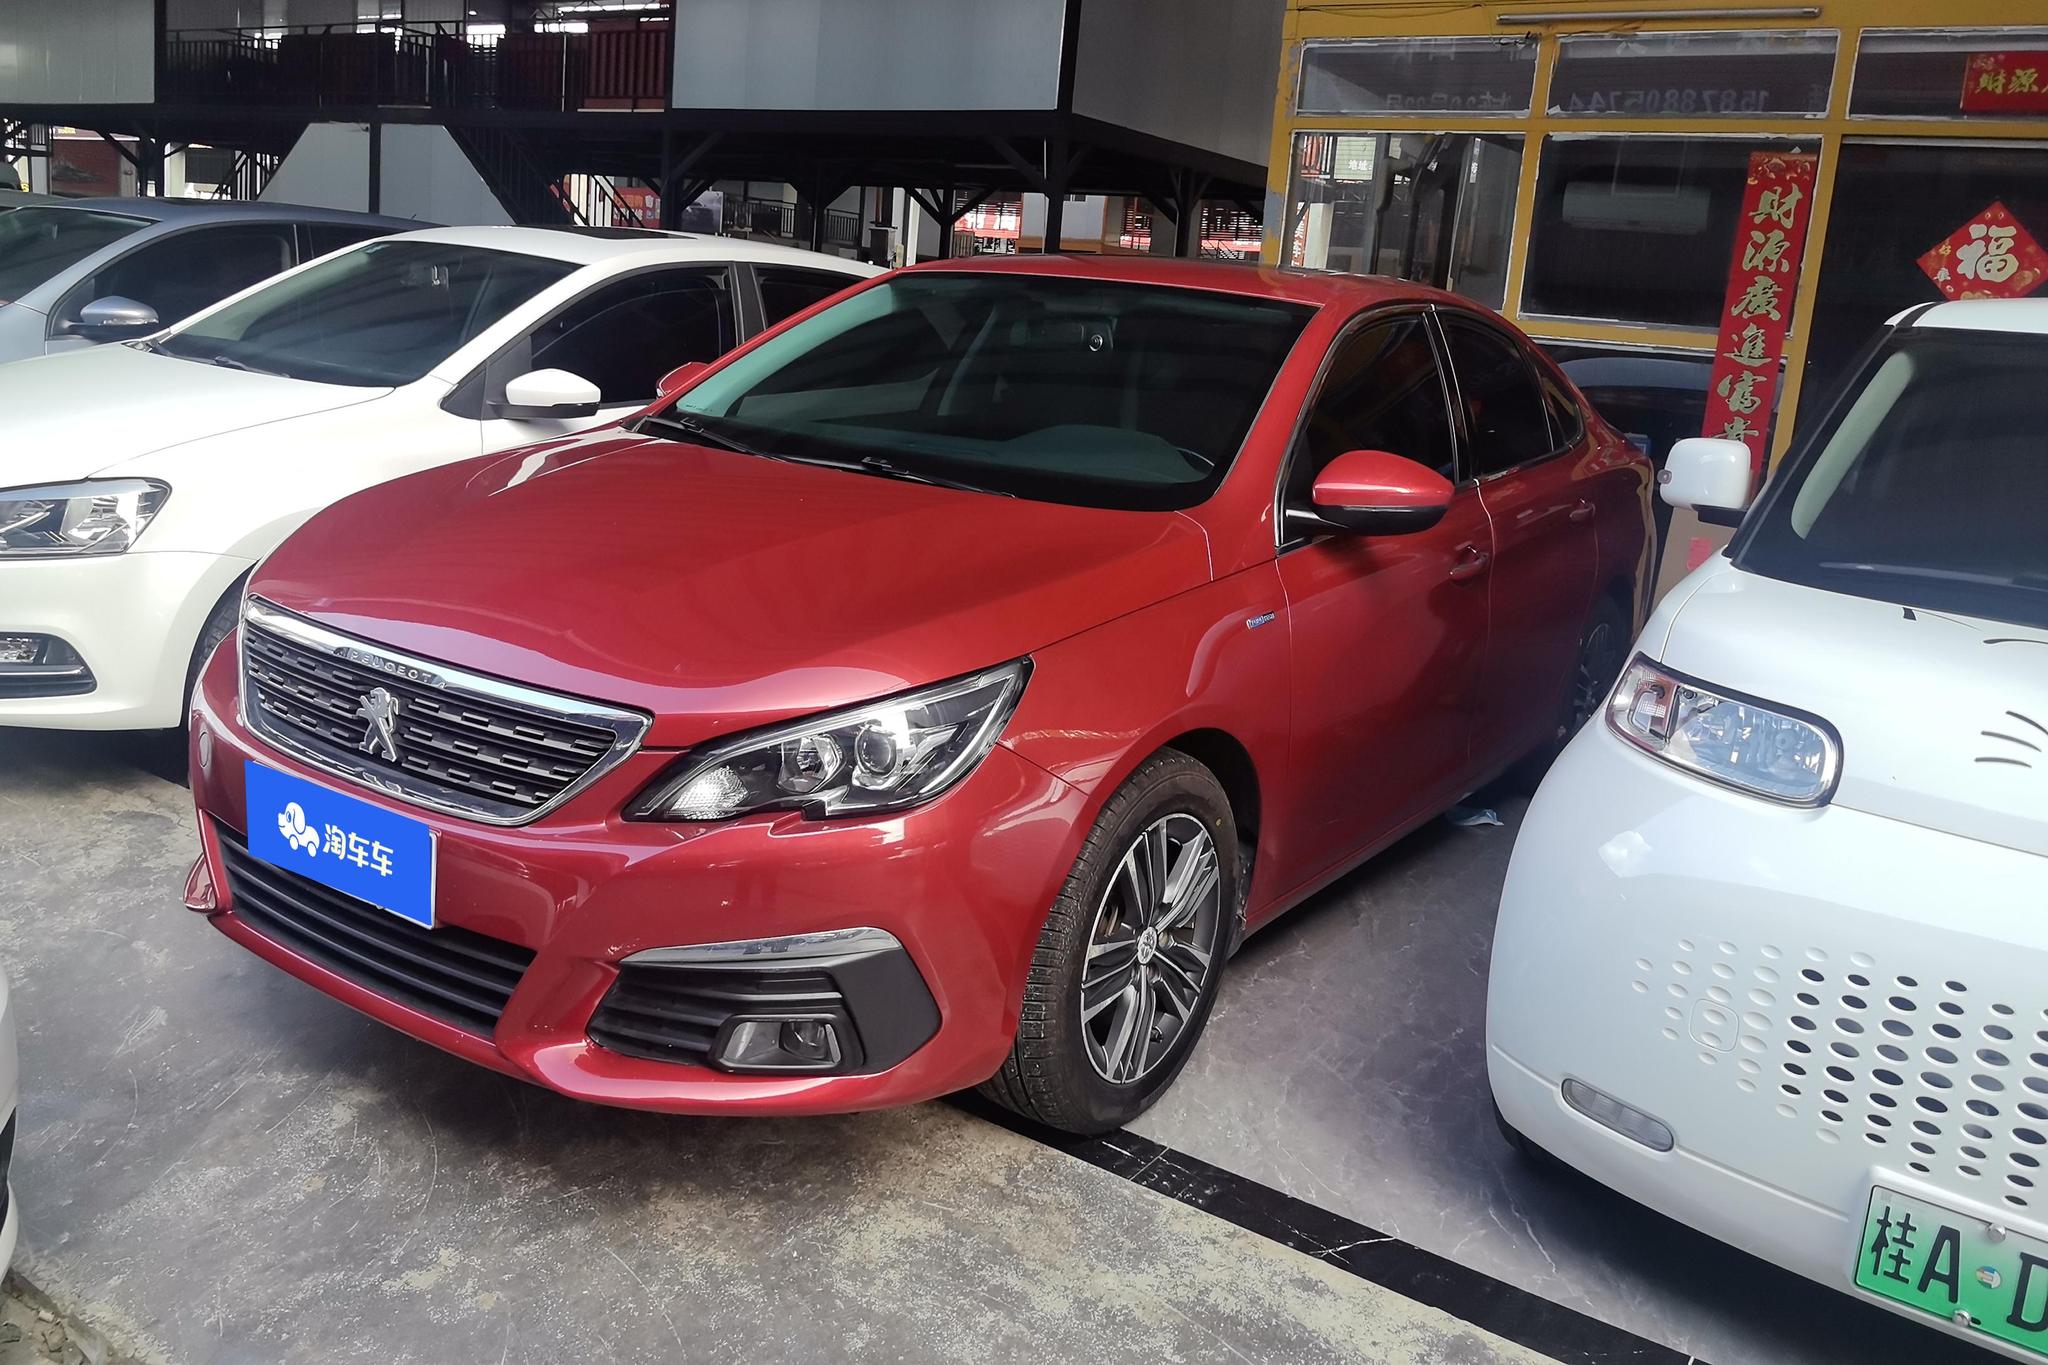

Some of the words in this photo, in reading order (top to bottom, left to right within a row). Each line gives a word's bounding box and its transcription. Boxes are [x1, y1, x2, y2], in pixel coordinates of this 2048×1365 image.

[1975, 68, 2048, 94] 財源
[1955, 222, 2020, 284] 福
[347, 650, 432, 683] PEUGEOT
